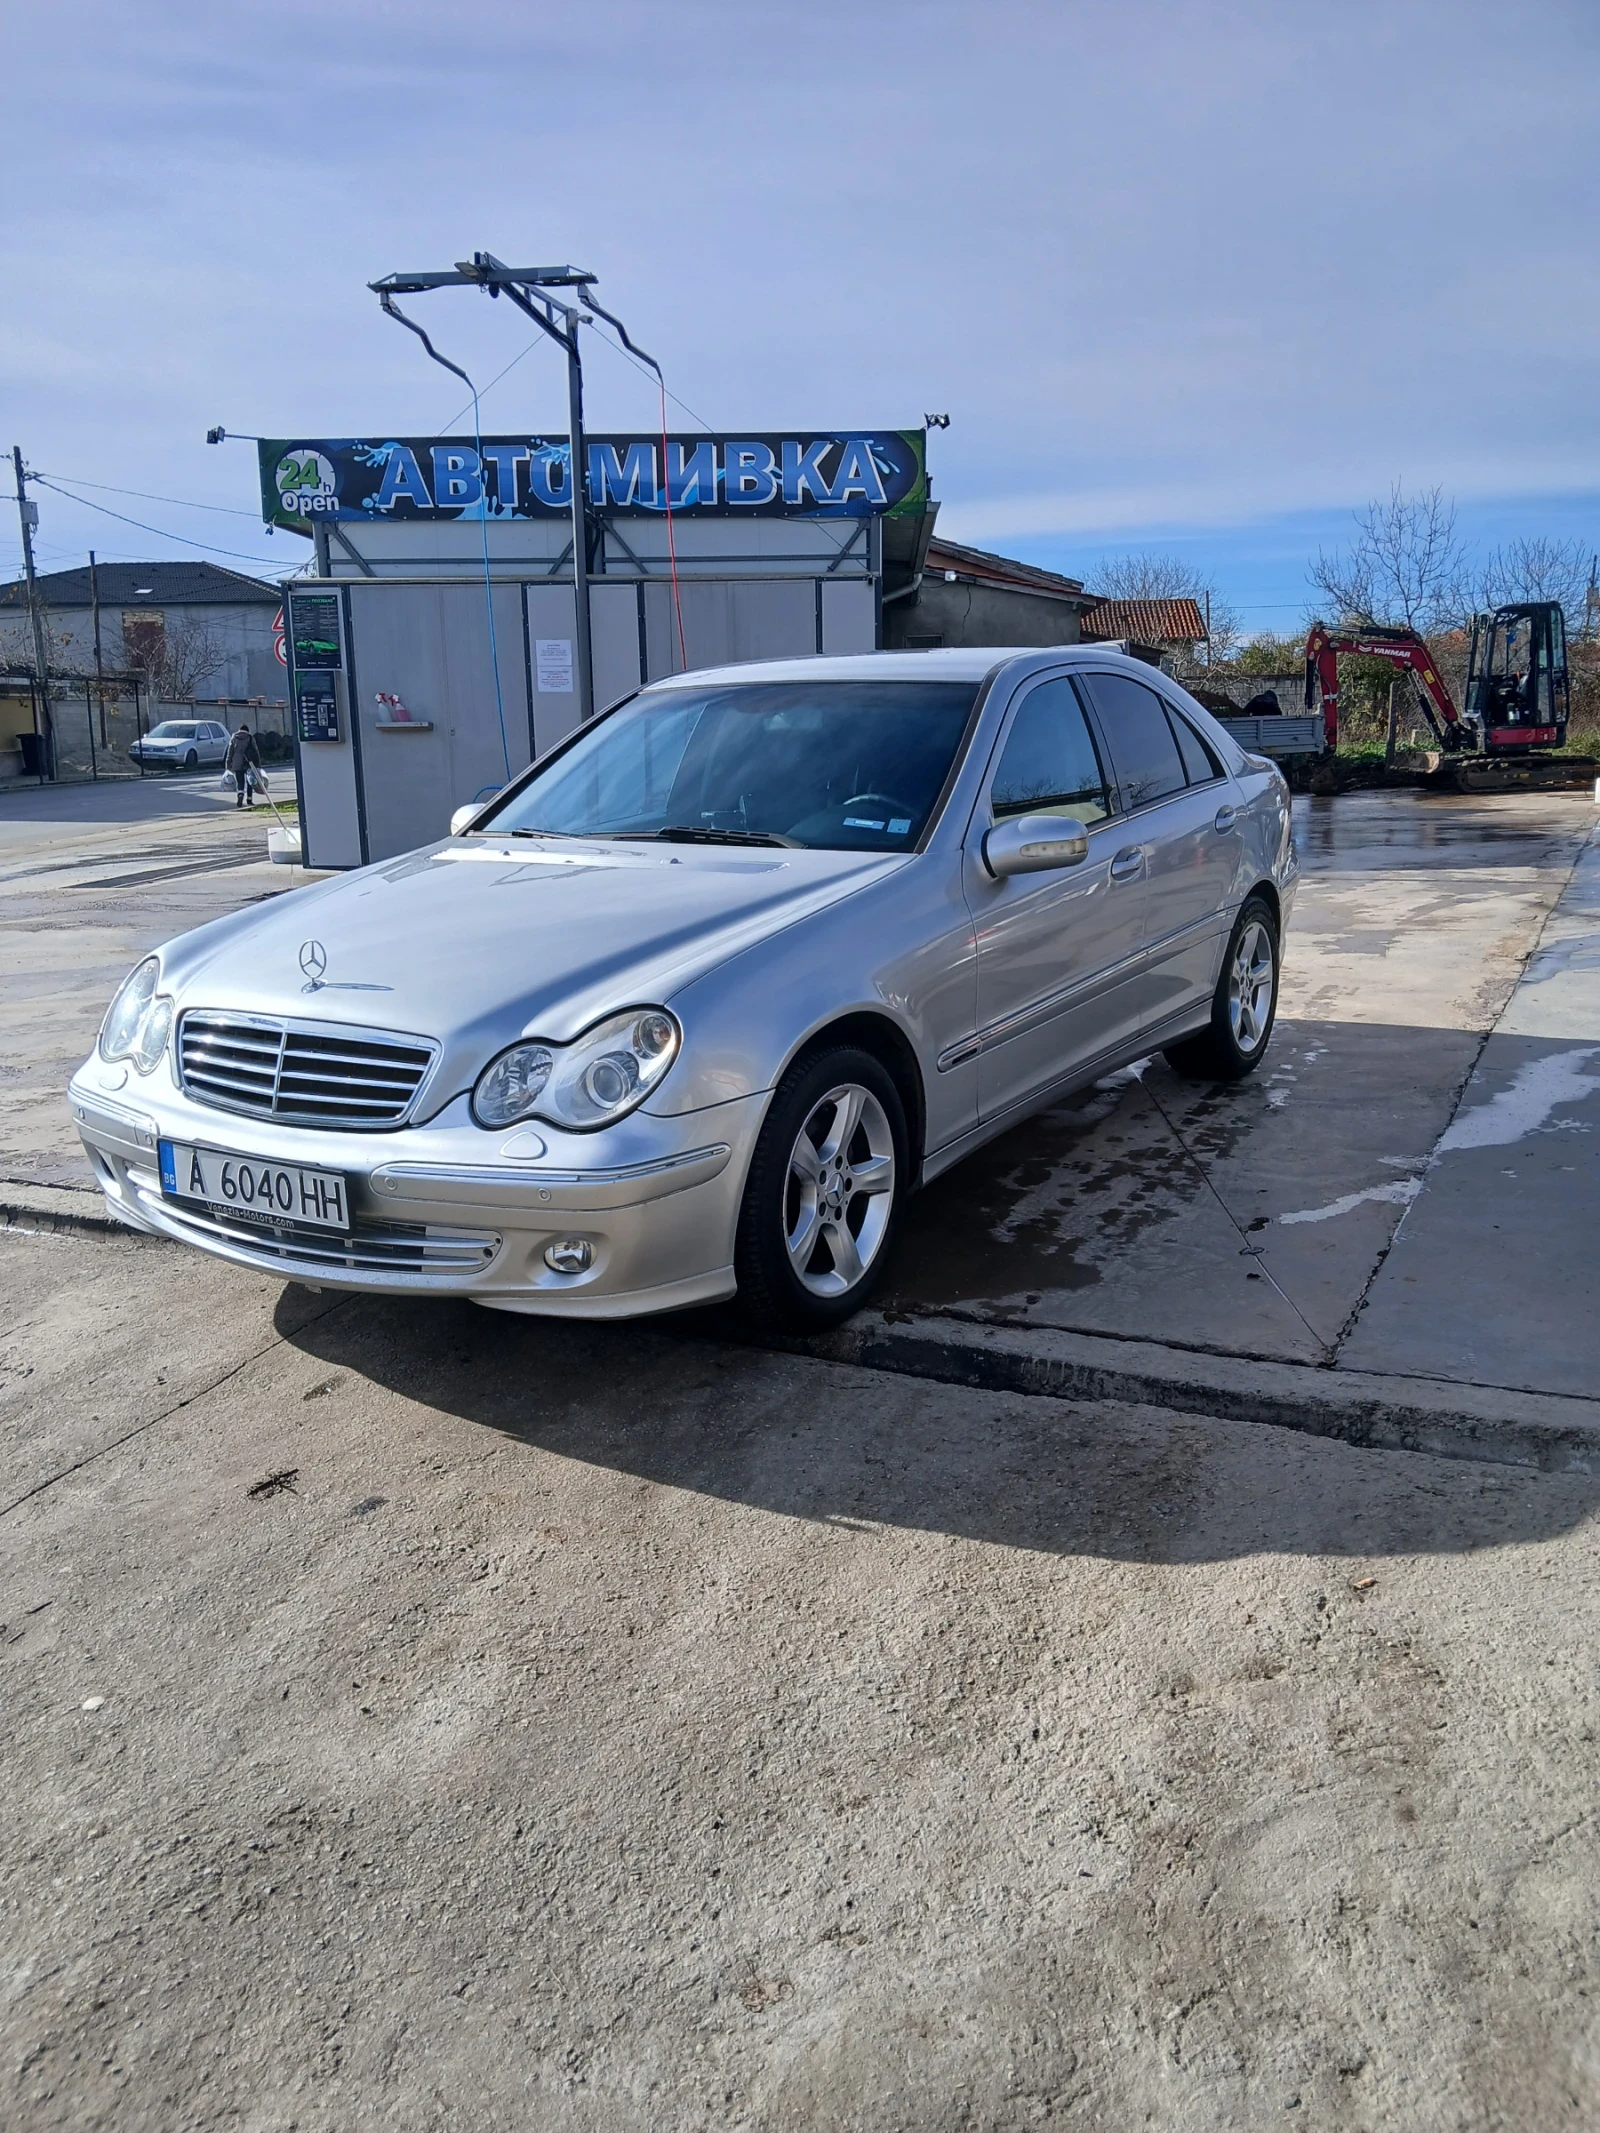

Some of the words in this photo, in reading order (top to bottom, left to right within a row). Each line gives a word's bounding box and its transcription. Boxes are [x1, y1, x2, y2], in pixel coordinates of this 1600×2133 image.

[279, 458, 321, 490] 24
[323, 482, 332, 493] h
[377, 440, 889, 509] АВТОМИВКА
[281, 490, 340, 517] Open
[1373, 647, 1411, 658] YANMAR
[164, 1172, 176, 1186] BG
[189, 1151, 206, 1195] A
[220, 1159, 293, 1212] 6040
[299, 1171, 344, 1222] HH
[206, 1200, 296, 1229] Venezia-Motors.com
